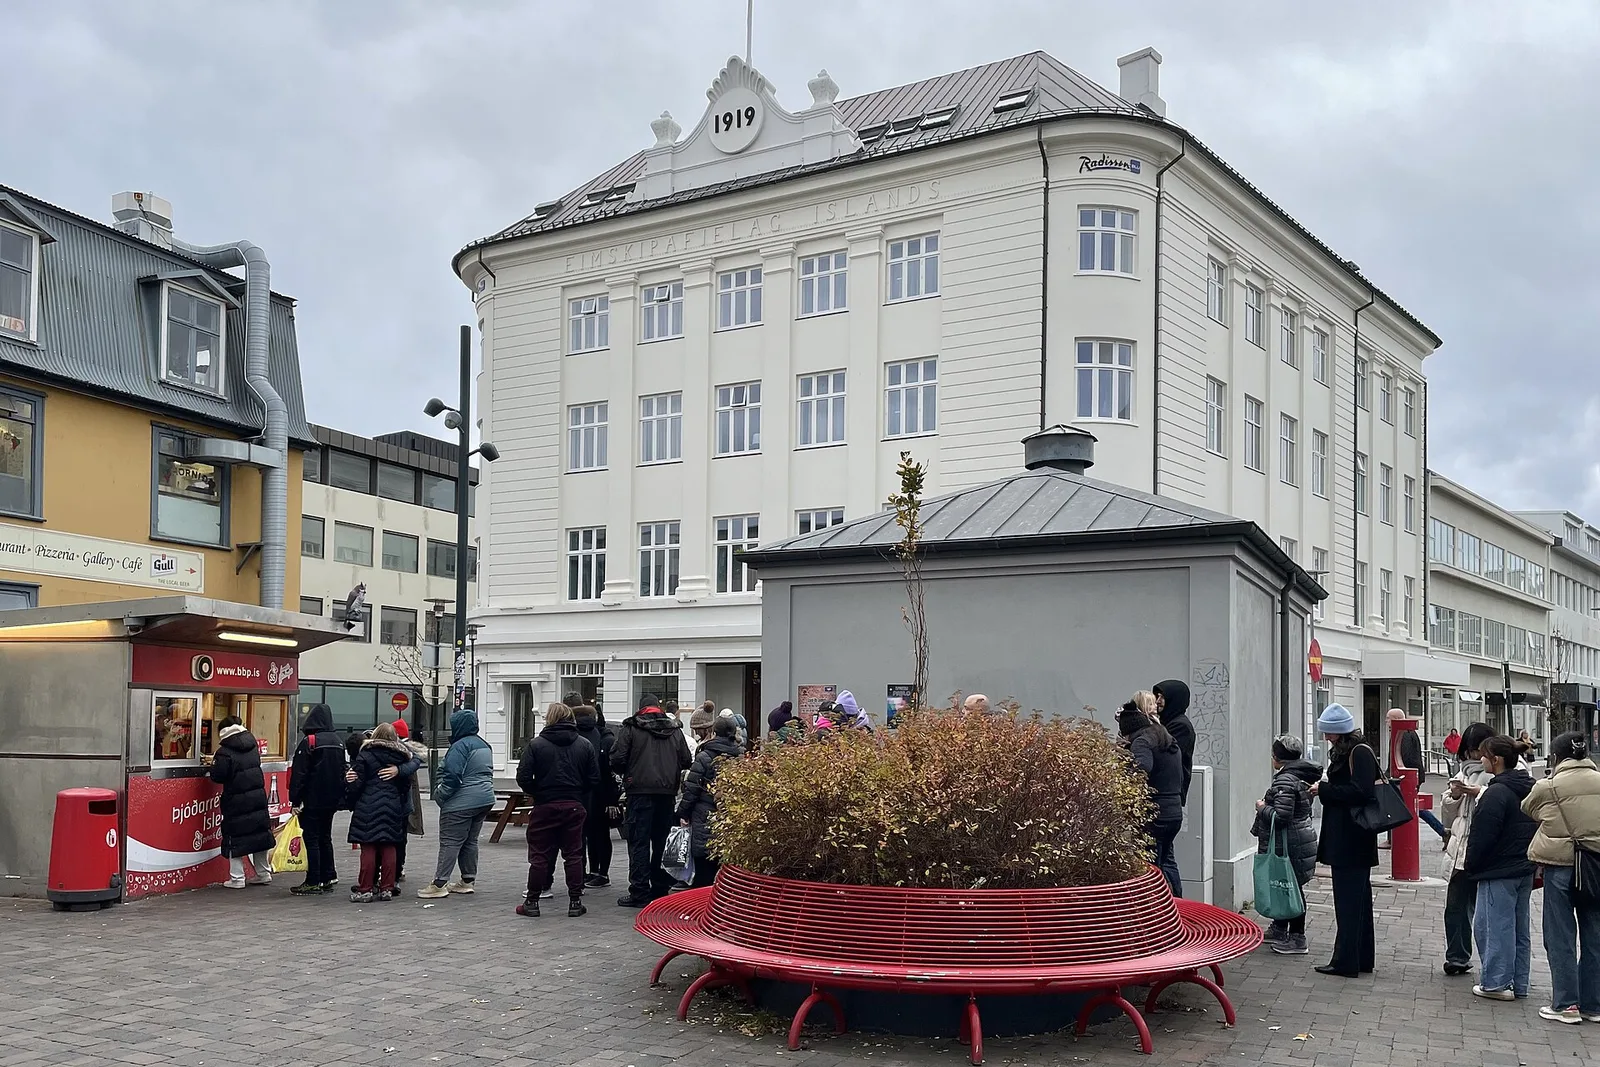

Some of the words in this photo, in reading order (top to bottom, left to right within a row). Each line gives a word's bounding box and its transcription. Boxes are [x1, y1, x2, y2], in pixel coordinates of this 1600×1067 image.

[714, 106, 756, 134] 1919
[1079, 153, 1130, 174] Radisson
[35, 544, 75, 561] Pizzeria
[82, 551, 116, 571] Gallery
[121, 556, 143, 574] Café
[153, 559, 174, 571] Gull
[216, 666, 261, 679] www.bbp.is
[172, 792, 223, 825] Þjóðarré
